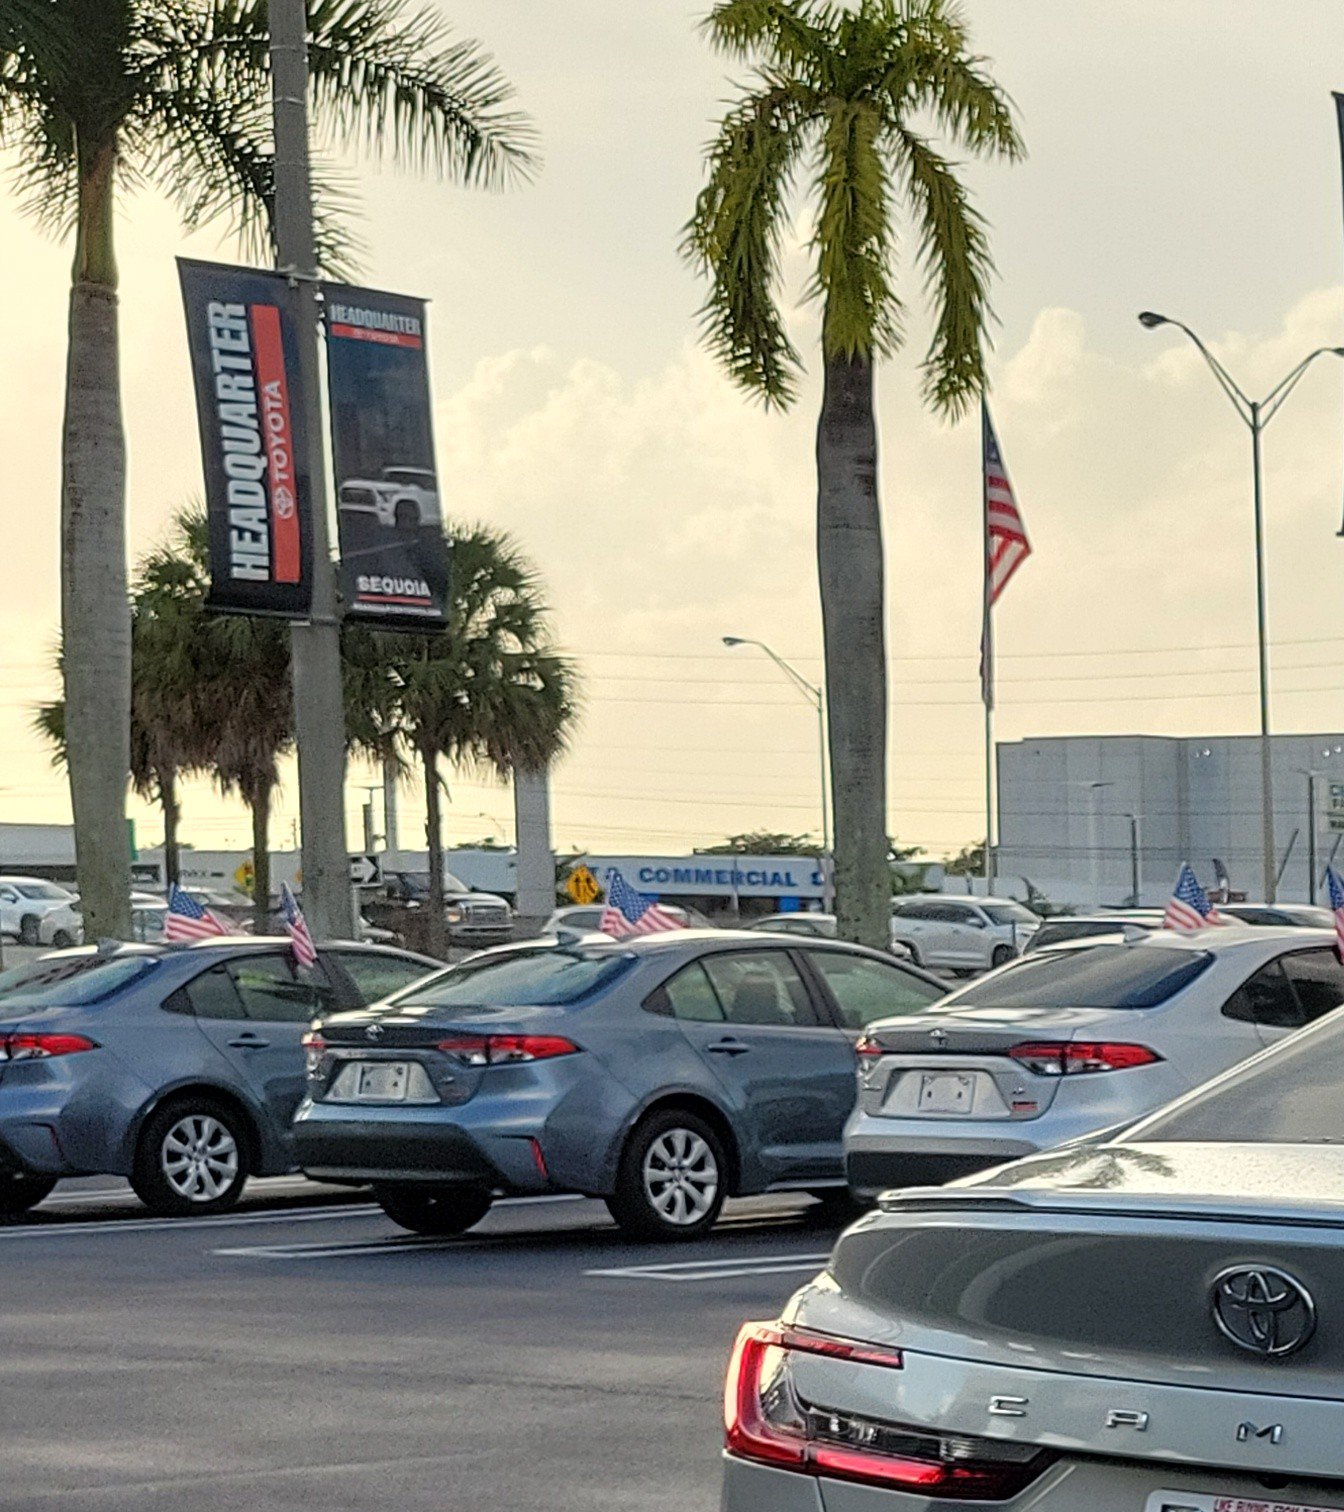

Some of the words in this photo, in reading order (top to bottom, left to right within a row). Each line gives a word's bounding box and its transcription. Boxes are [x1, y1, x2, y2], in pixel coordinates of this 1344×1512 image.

[208, 302, 269, 580] HEADQUARTER
[264, 380, 291, 482] TOYOTA
[357, 575, 432, 597] SEQUOIA
[639, 867, 798, 887] COMMERCIAL
